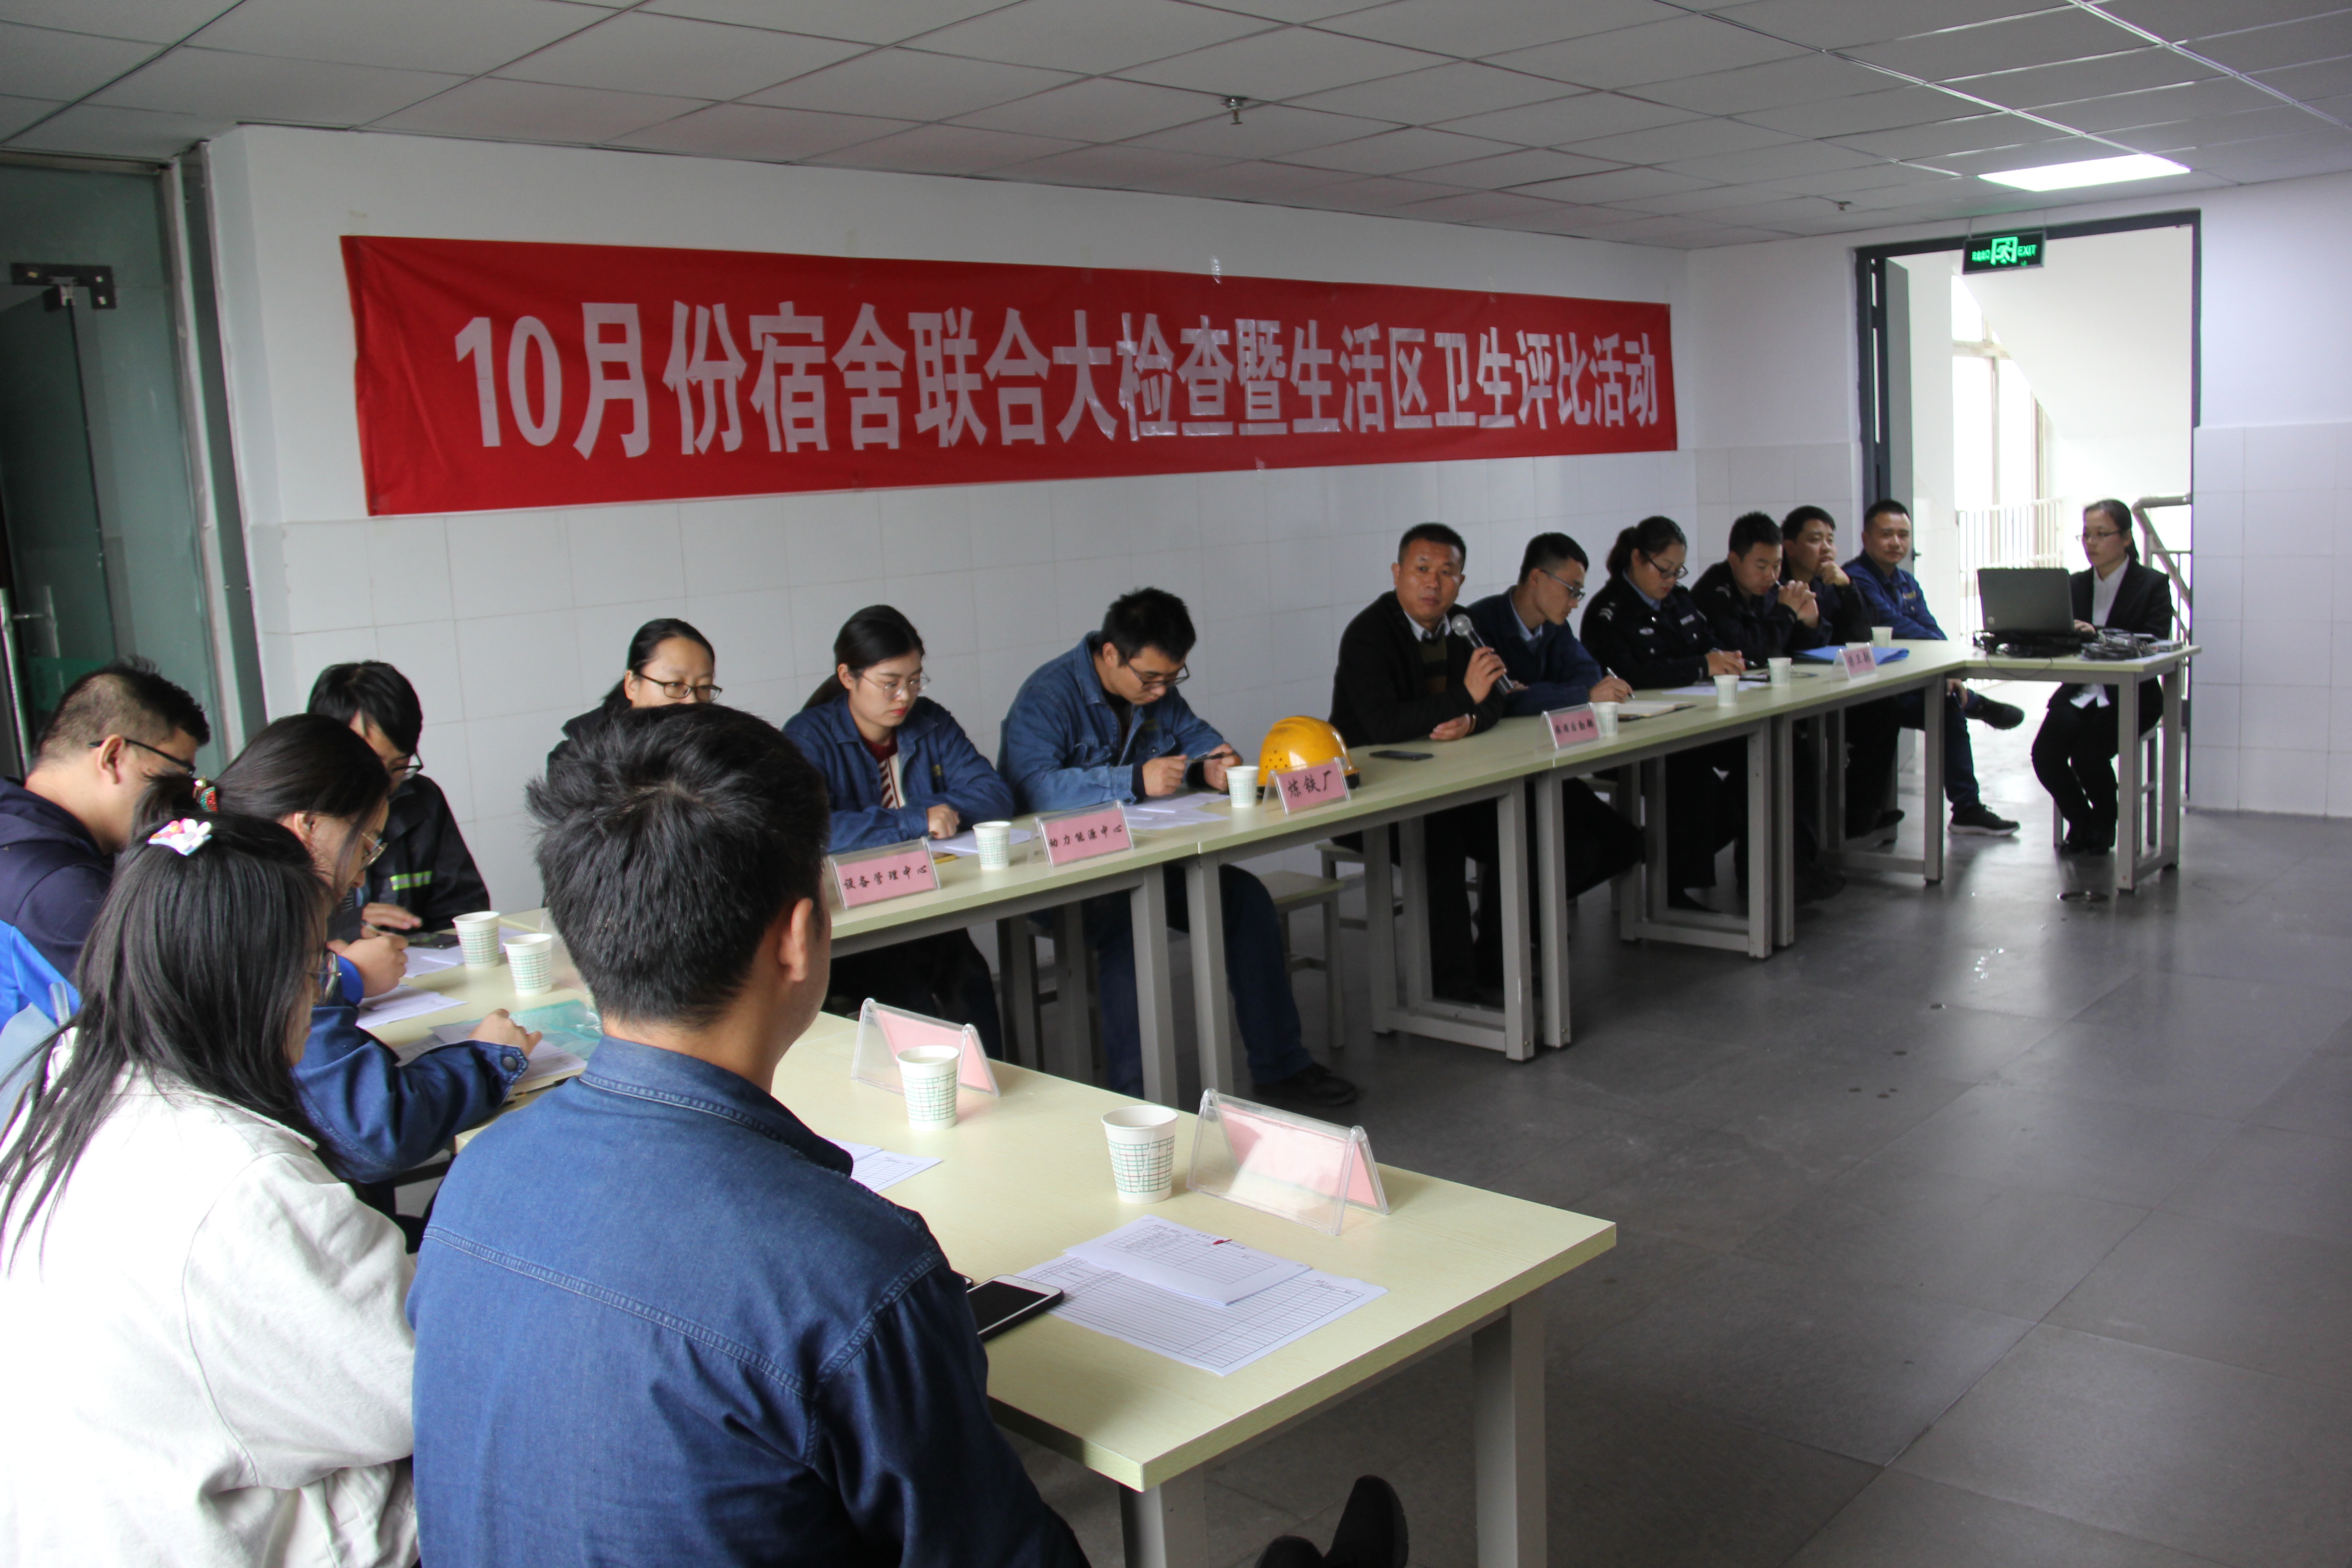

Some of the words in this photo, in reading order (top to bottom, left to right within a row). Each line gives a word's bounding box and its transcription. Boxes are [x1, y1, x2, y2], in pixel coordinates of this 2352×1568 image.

[2017, 244, 2037, 257] EXIT
[455, 300, 1658, 460] 10月份宿舍联合大检查暨生活区卫生评比活动
[1287, 770, 1331, 798] 炼铁厂
[1049, 825, 1122, 848] 动力能源中心
[844, 865, 927, 890] 设备管理中心
